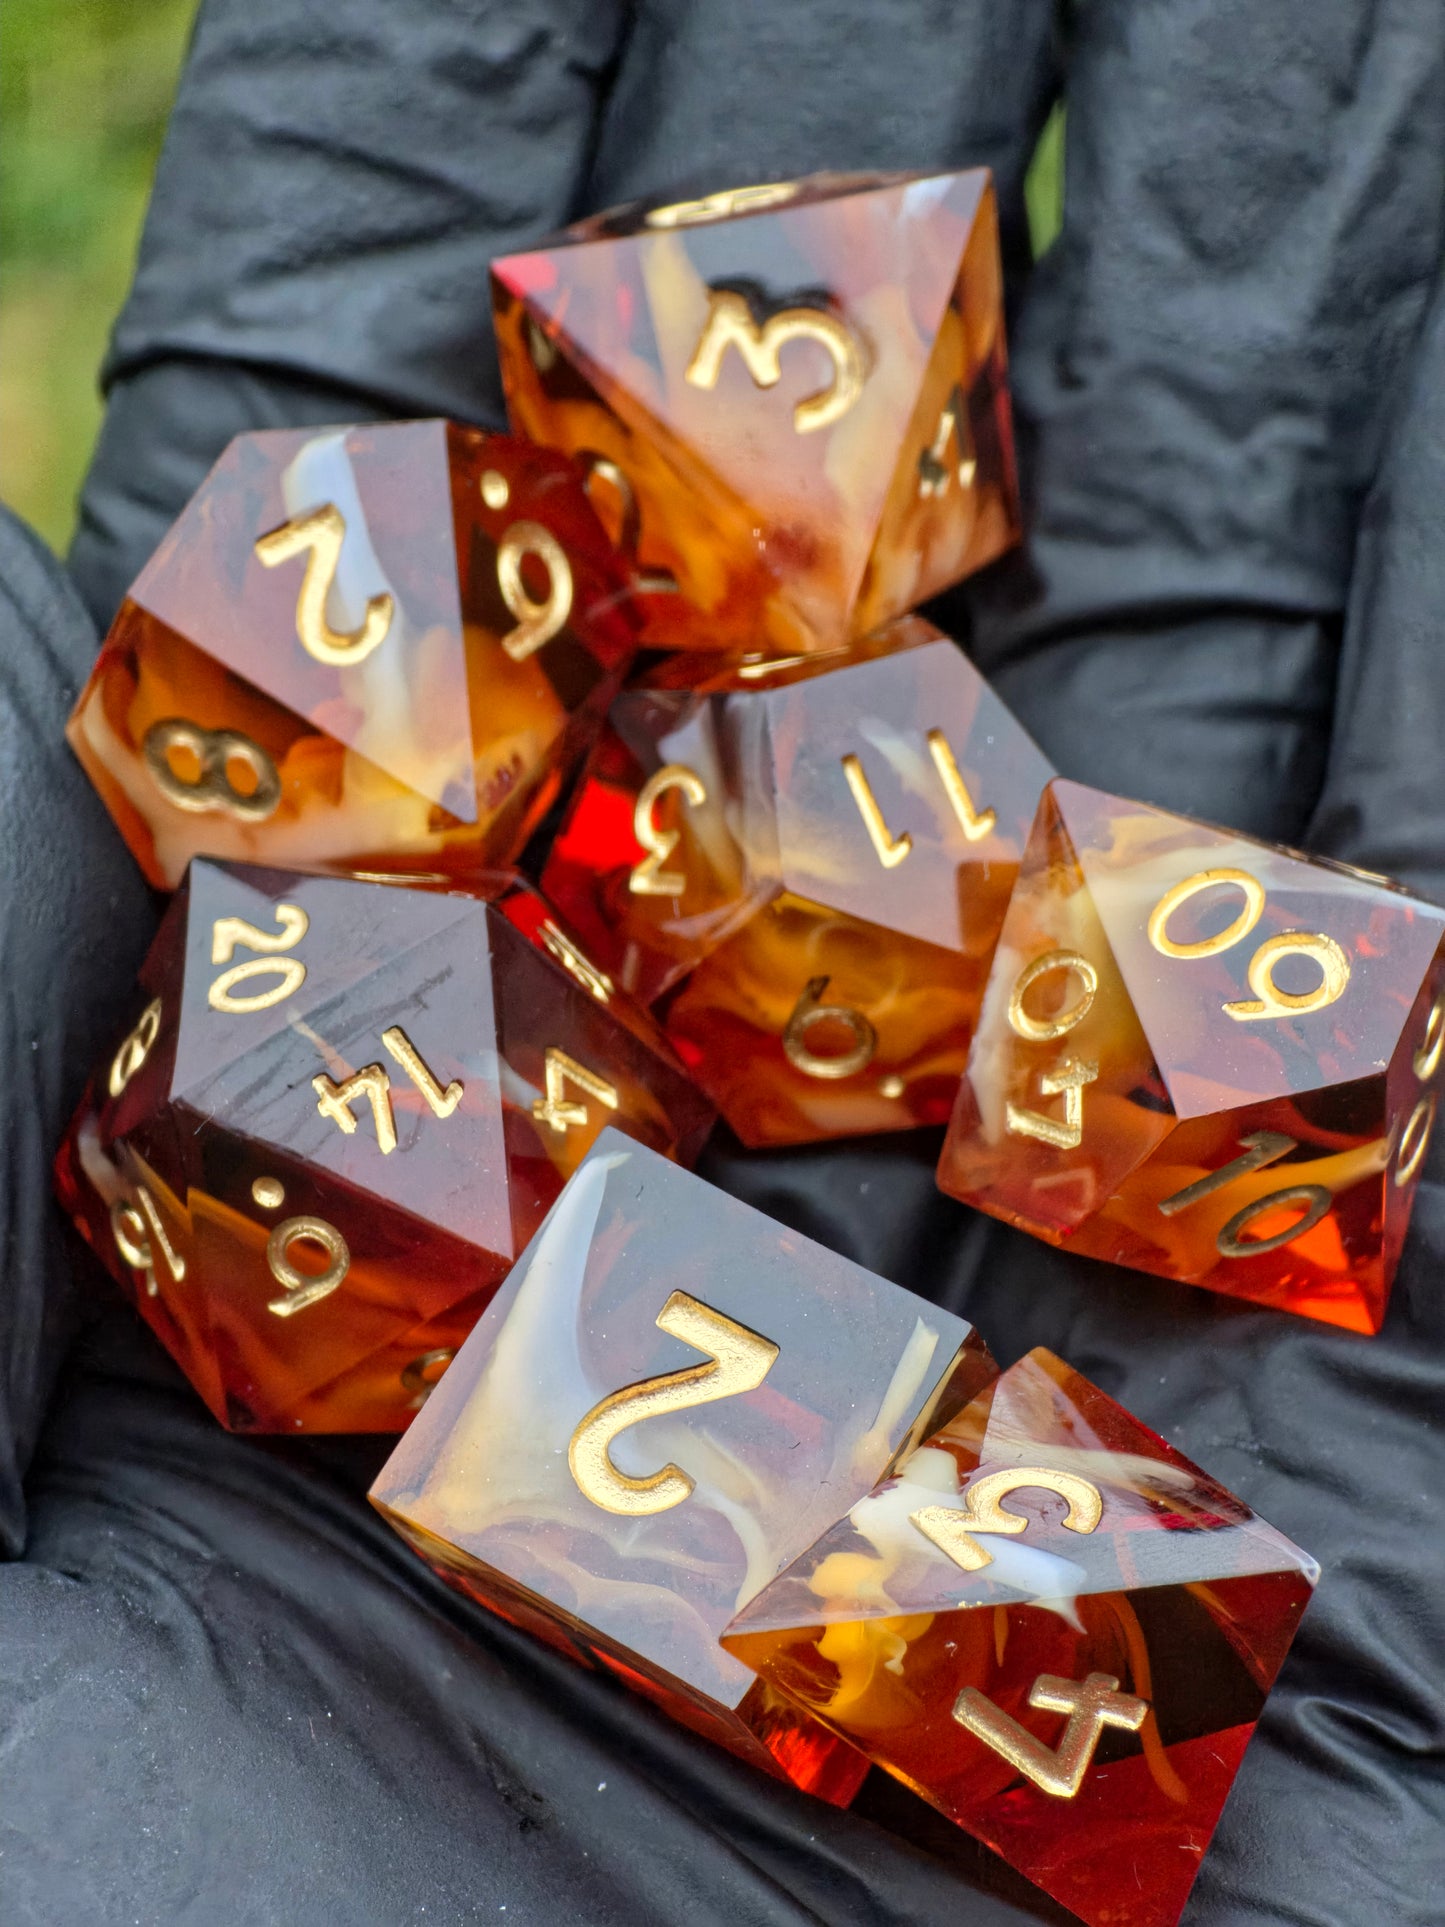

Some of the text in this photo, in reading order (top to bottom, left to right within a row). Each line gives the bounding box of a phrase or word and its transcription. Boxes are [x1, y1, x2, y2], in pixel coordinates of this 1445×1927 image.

[685, 286, 868, 436] 3
[143, 717, 281, 822] 8
[842, 727, 997, 869] 11
[208, 905, 309, 1014] 20
[312, 1025, 463, 1154] 14
[533, 1046, 619, 1132] 4
[1158, 1130, 1331, 1258] 10
[567, 1288, 780, 1516] 2
[910, 1468, 1103, 1572] 3
[952, 1673, 1149, 1798] 4
